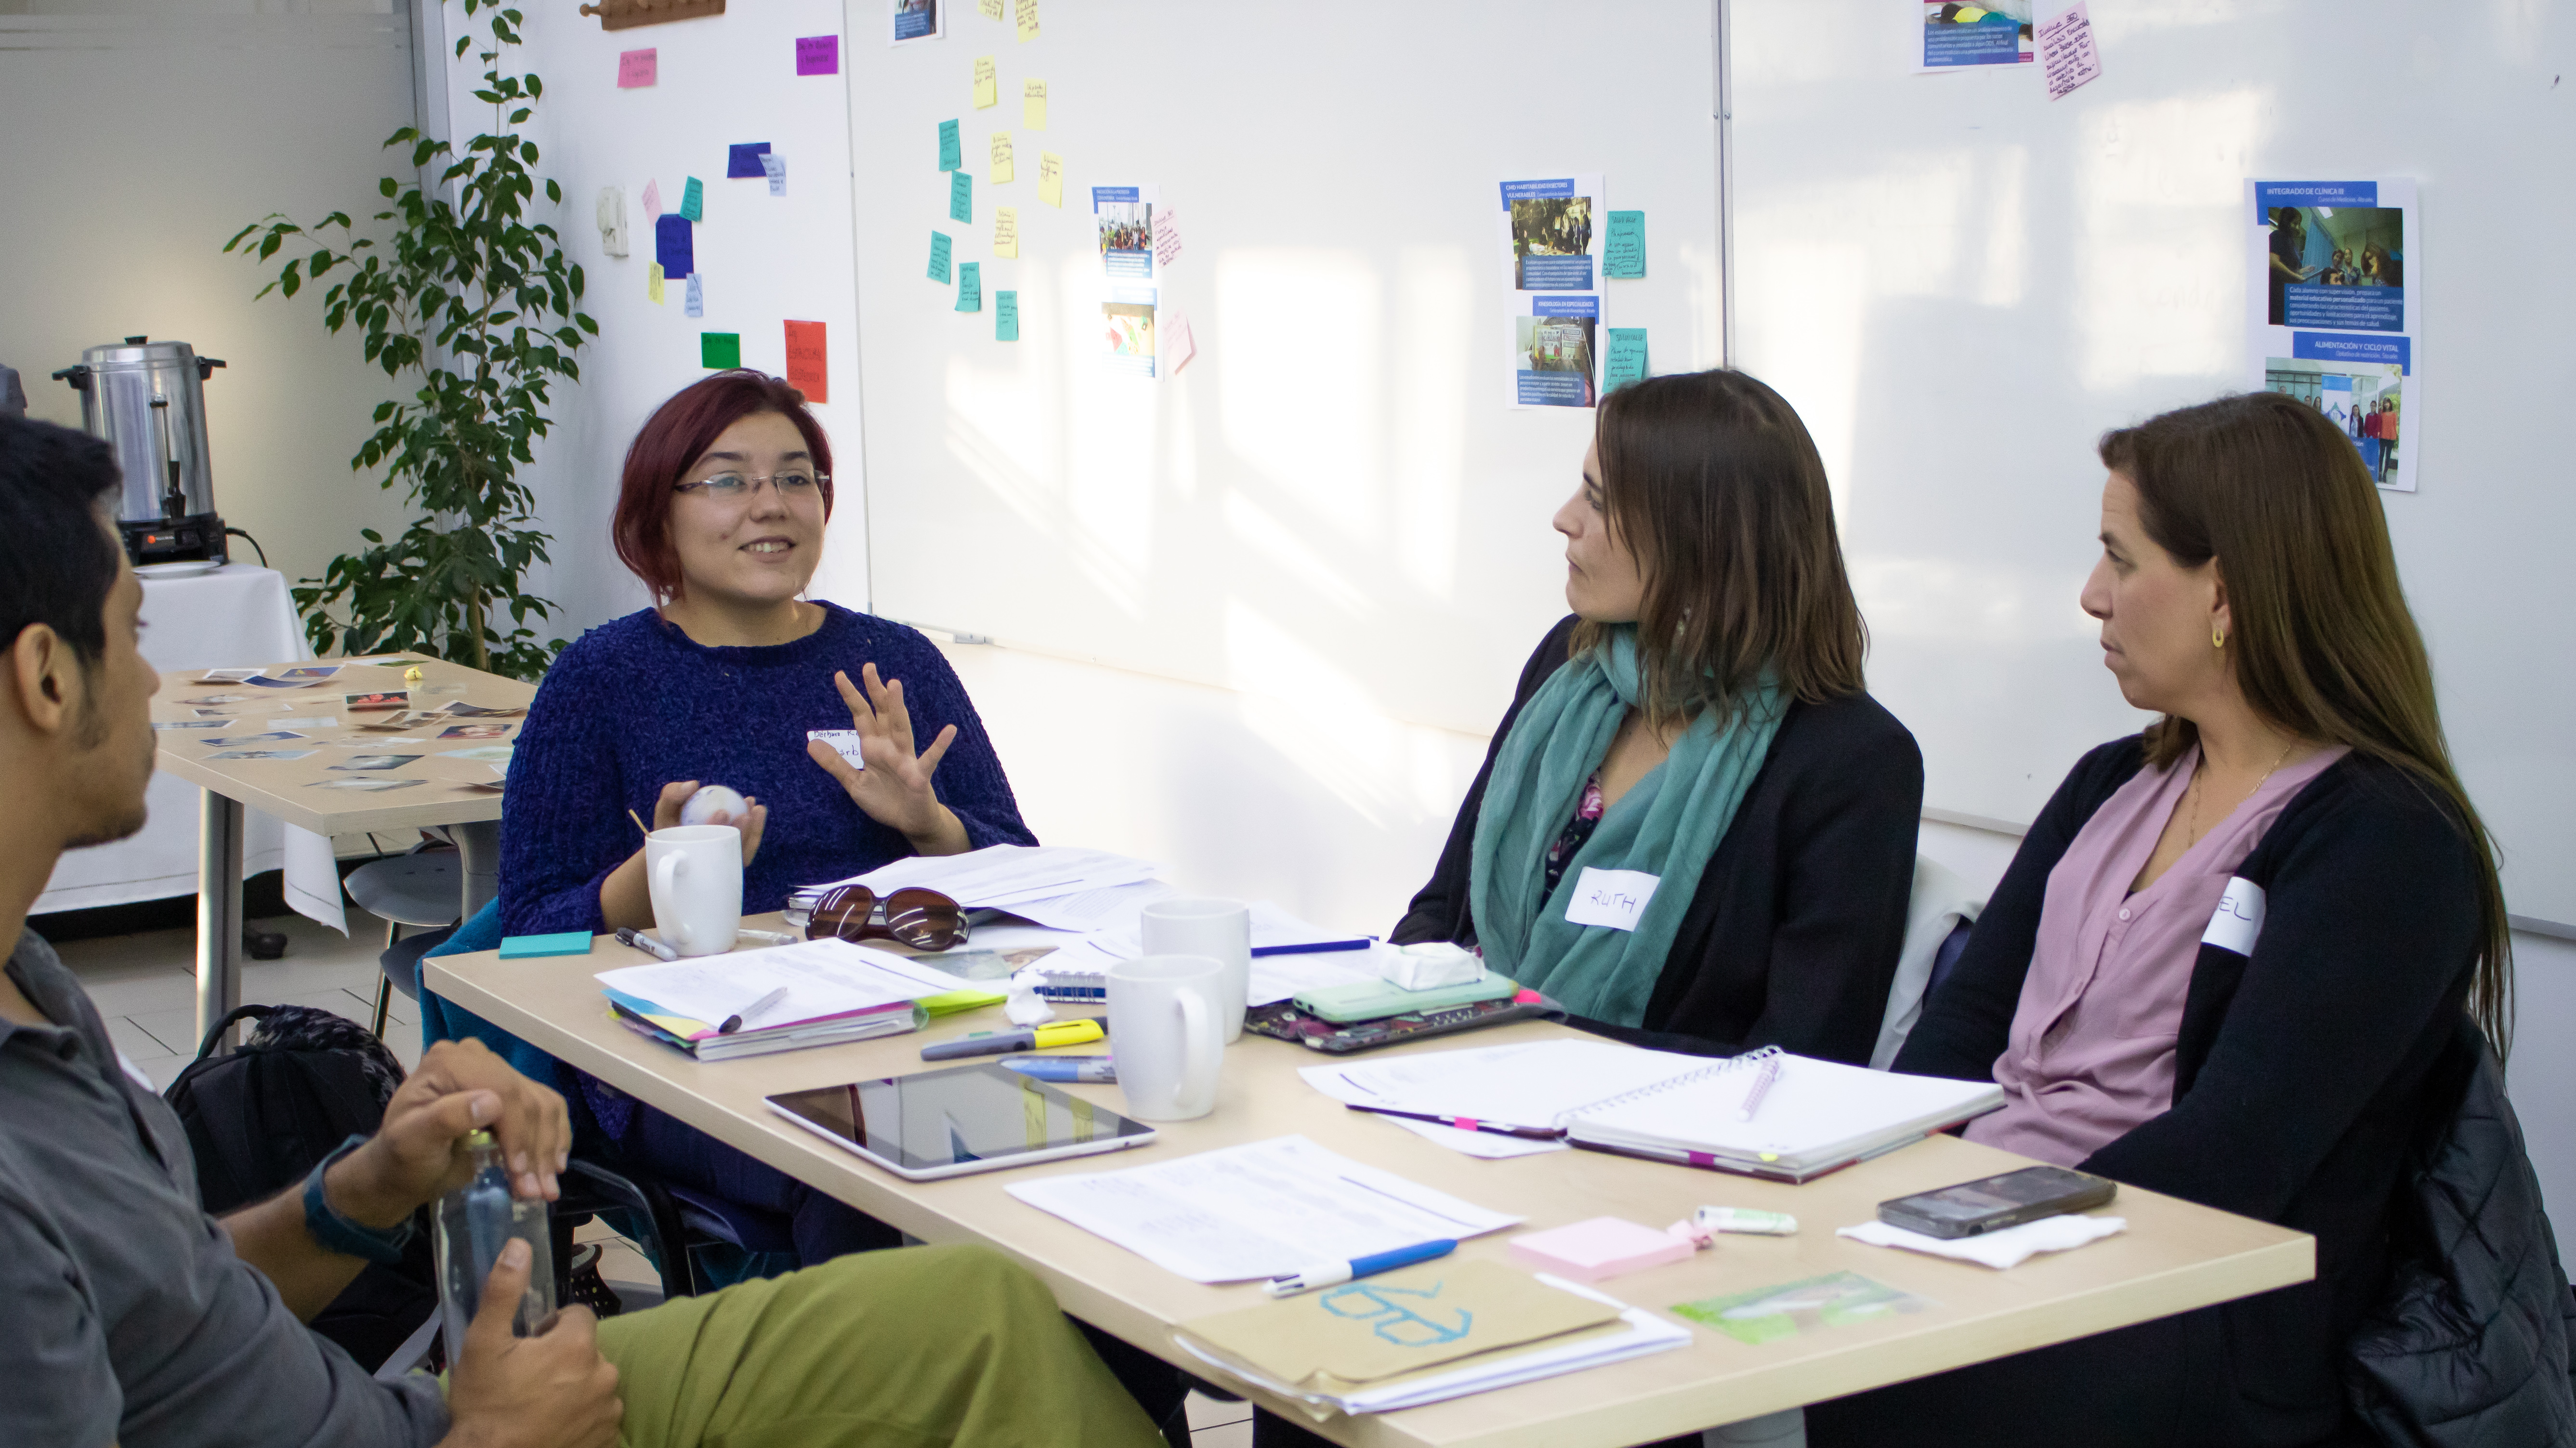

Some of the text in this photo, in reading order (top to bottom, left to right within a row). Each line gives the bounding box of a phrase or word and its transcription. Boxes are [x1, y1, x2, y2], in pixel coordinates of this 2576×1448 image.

[2314, 186, 2338, 195] CLÍNICA
[2315, 341, 2358, 349] ALIMENTACIÓN
[1590, 890, 1636, 914] RUTH
[2219, 896, 2252, 921] EL
